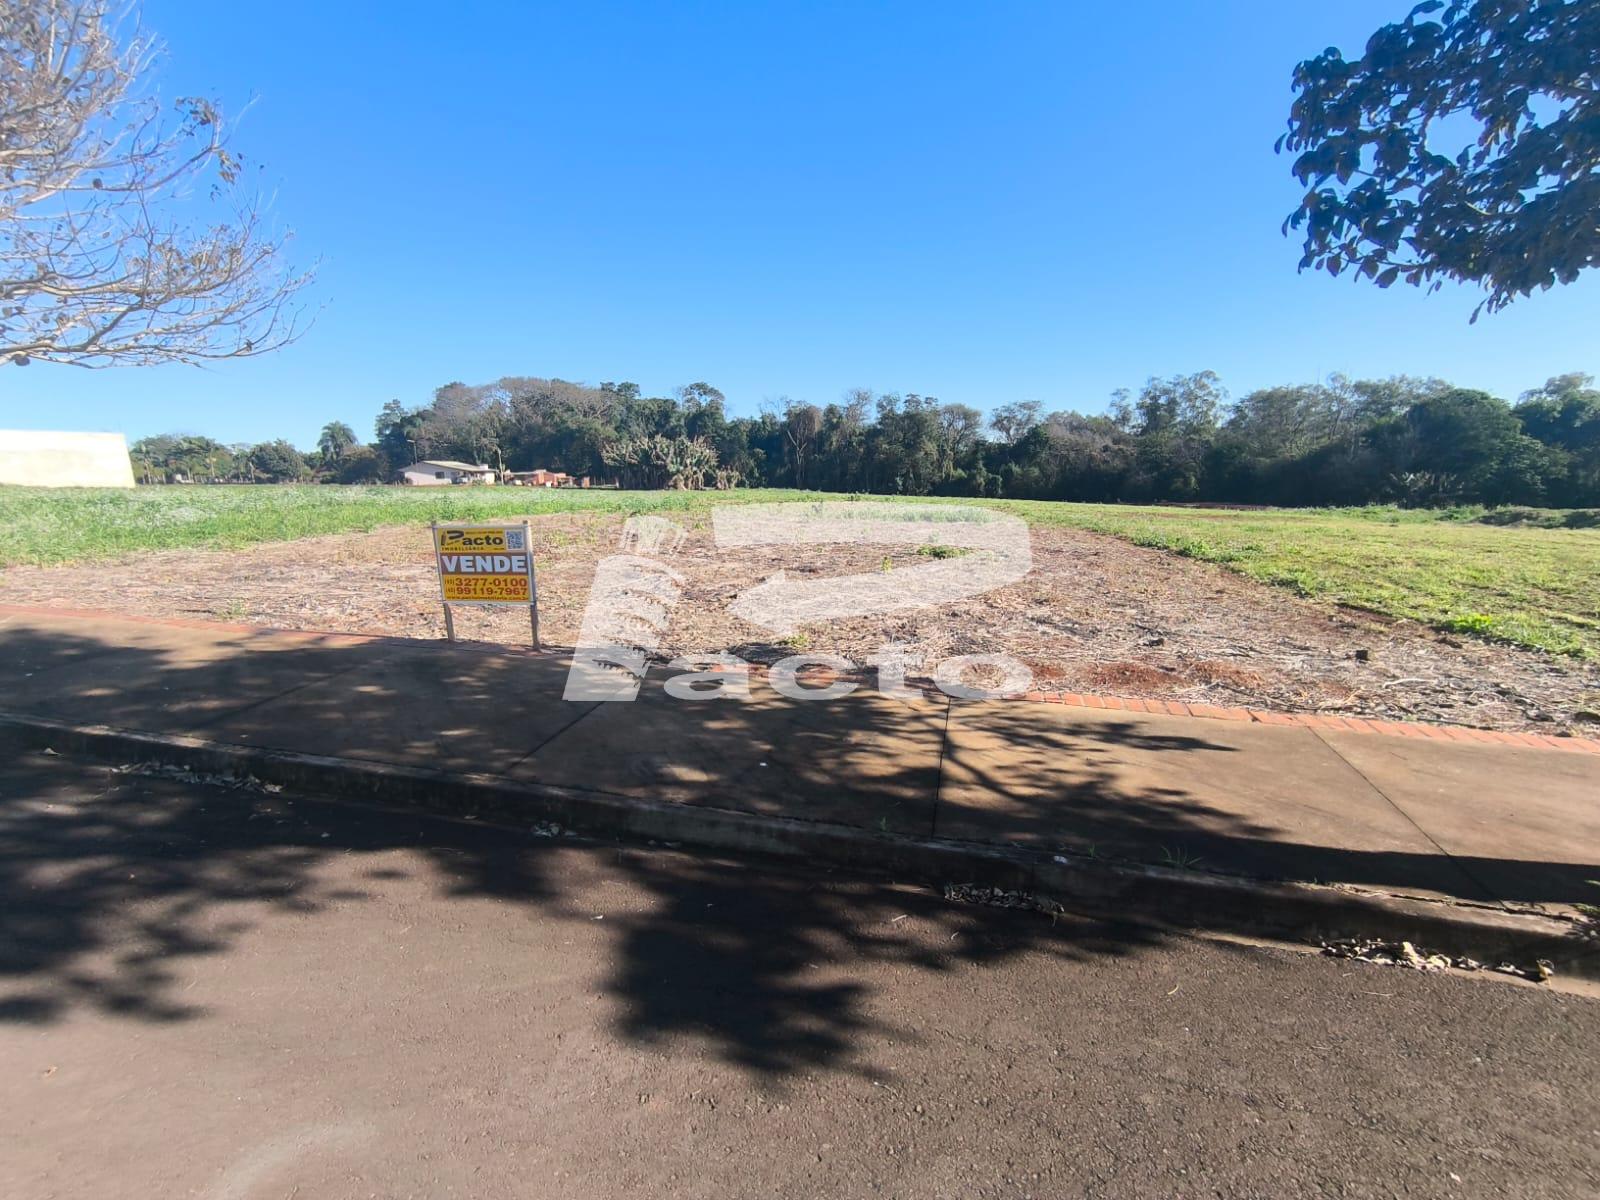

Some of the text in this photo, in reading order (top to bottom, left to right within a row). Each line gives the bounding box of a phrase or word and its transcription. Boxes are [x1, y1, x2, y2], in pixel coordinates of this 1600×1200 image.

[440, 530, 504, 546] Pacto
[441, 555, 528, 573] VENDE
[456, 577, 528, 587] 3277-0100
